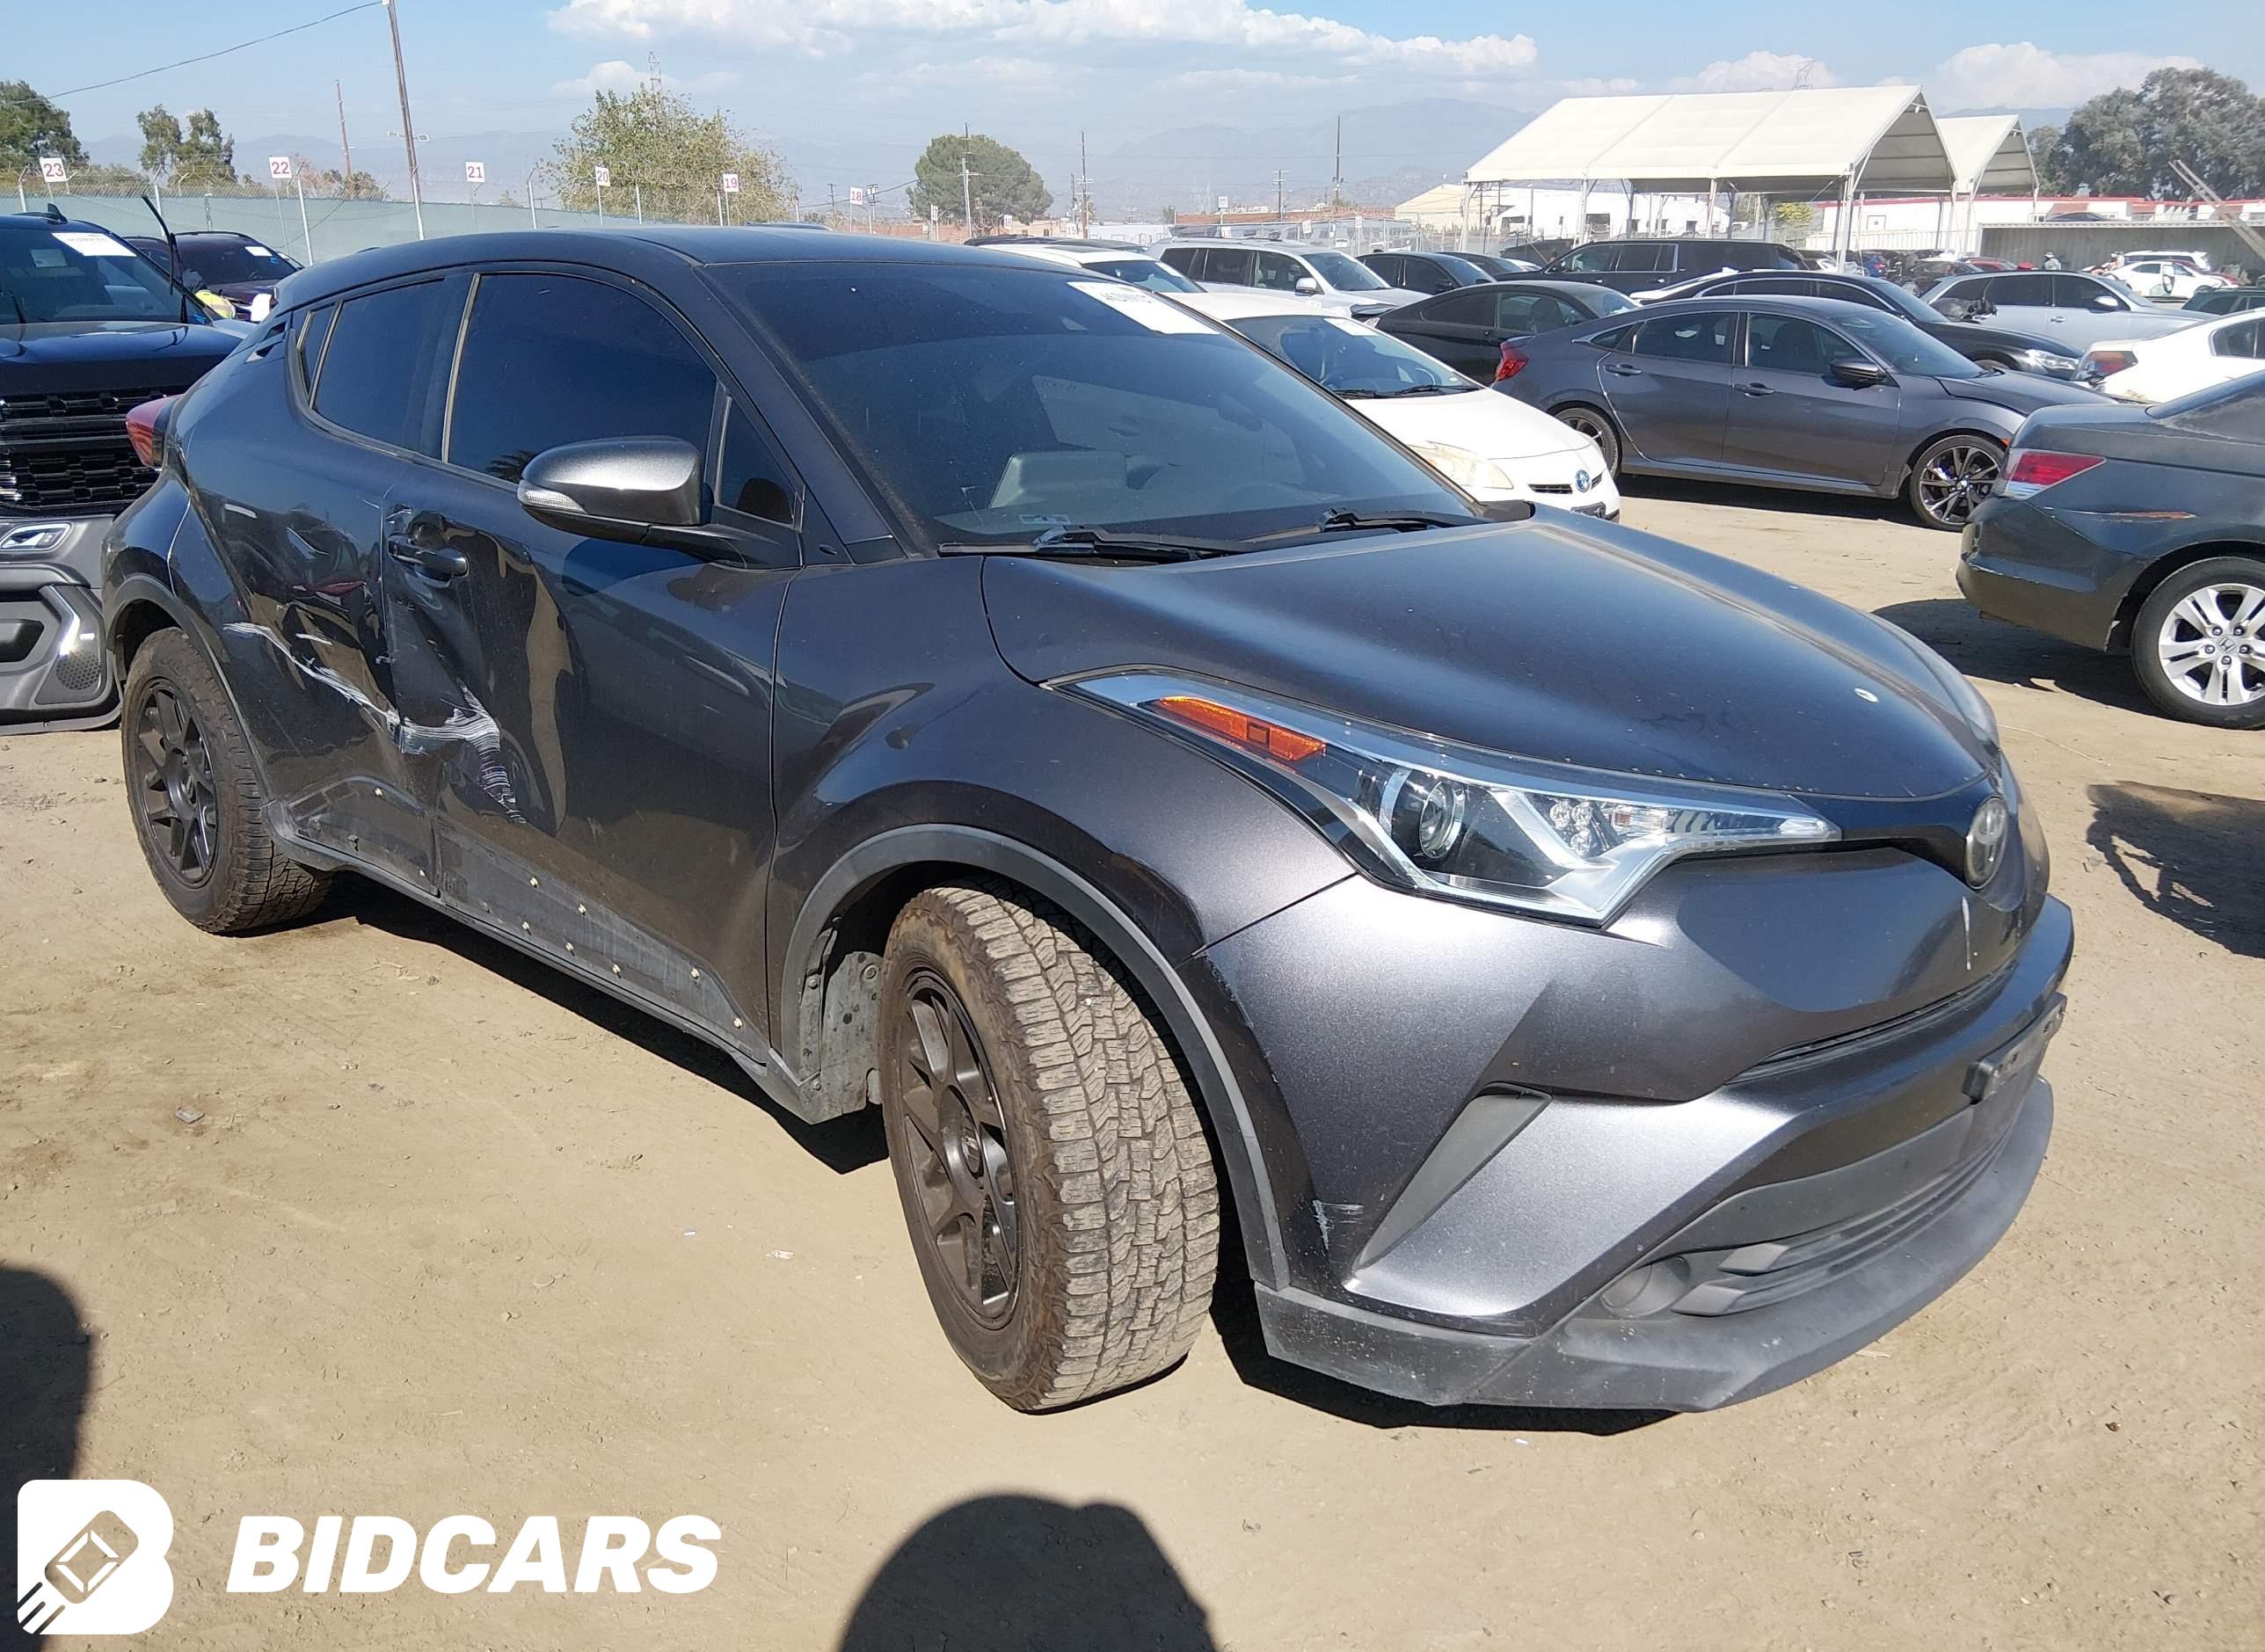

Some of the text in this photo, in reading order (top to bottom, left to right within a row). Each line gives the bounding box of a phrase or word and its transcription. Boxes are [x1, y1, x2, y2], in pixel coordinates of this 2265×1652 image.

[44, 163, 64, 178] 23
[272, 161, 290, 174] 22
[468, 165, 484, 178] 21
[597, 170, 608, 183] 20
[725, 177, 738, 188] 19
[851, 191, 862, 202] 18
